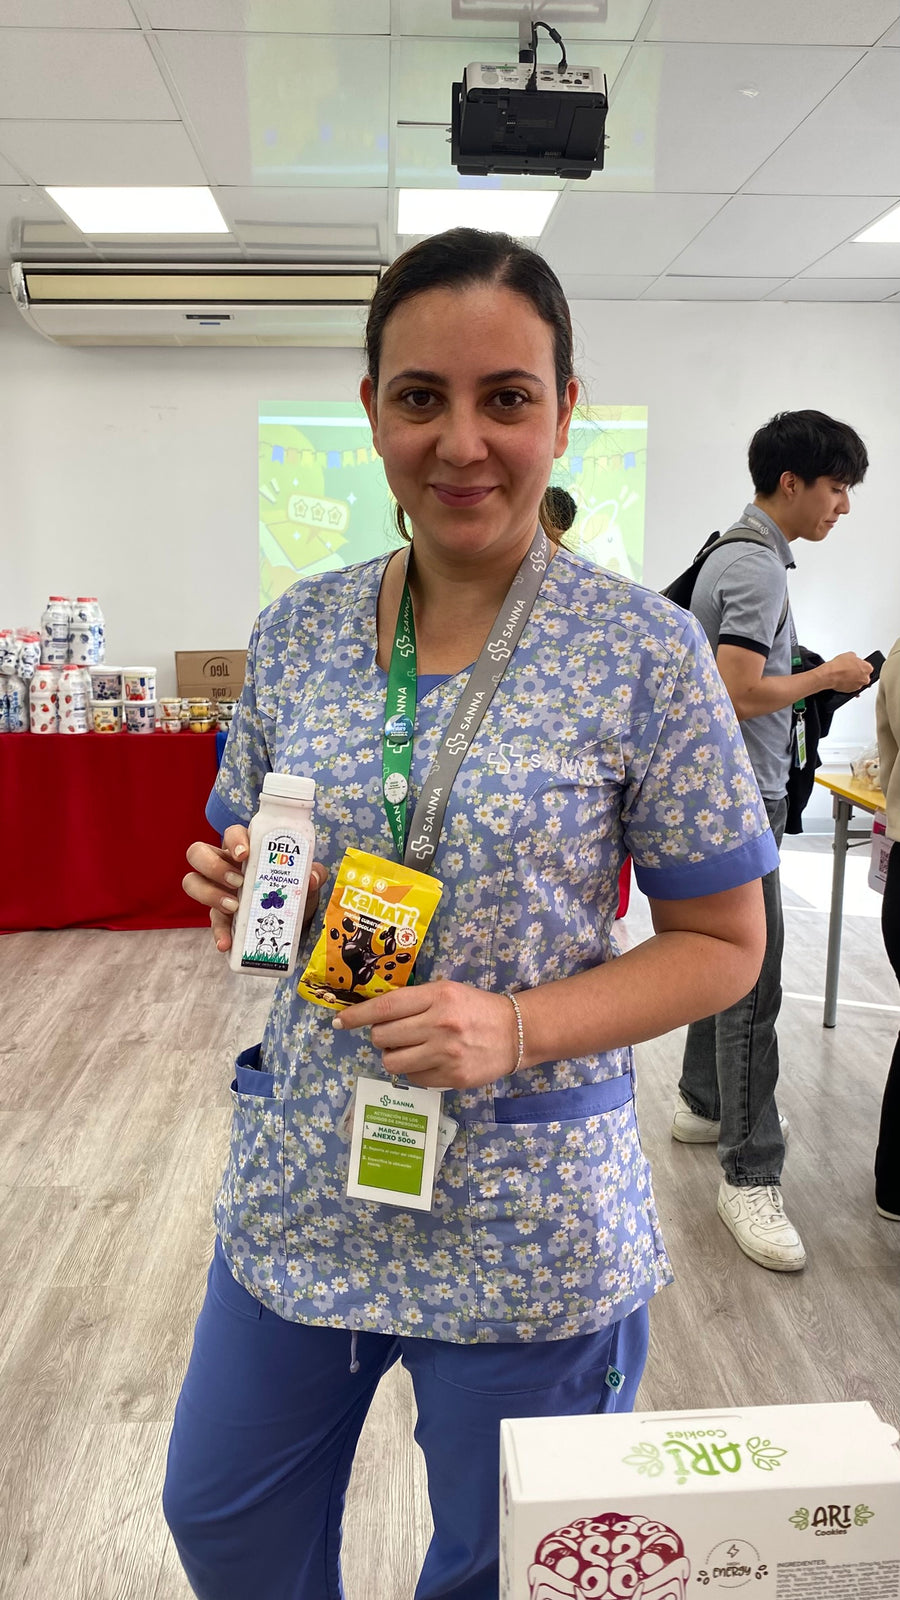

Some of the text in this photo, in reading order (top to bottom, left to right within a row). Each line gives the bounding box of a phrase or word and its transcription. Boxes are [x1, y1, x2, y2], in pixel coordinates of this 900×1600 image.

[502, 599, 527, 639] SANNA
[210, 662, 230, 677] TIGO
[396, 686, 408, 713] NNA
[459, 690, 486, 732] SANNA
[530, 753, 598, 779] SANNA
[424, 786, 443, 833] SANNA
[393, 805, 403, 832] SAN
[267, 841, 301, 855] DELA
[268, 853, 295, 867] KIDS
[270, 868, 291, 876] YOGURT
[392, 1100, 414, 1108] SANNA
[378, 1127, 400, 1135] MARCA
[372, 1132, 416, 1145] ANEXO 5000
[666, 1430, 728, 1441] Cookies
[814, 1528, 848, 1537] Cookies
[712, 1565, 752, 1579] ENERGY
